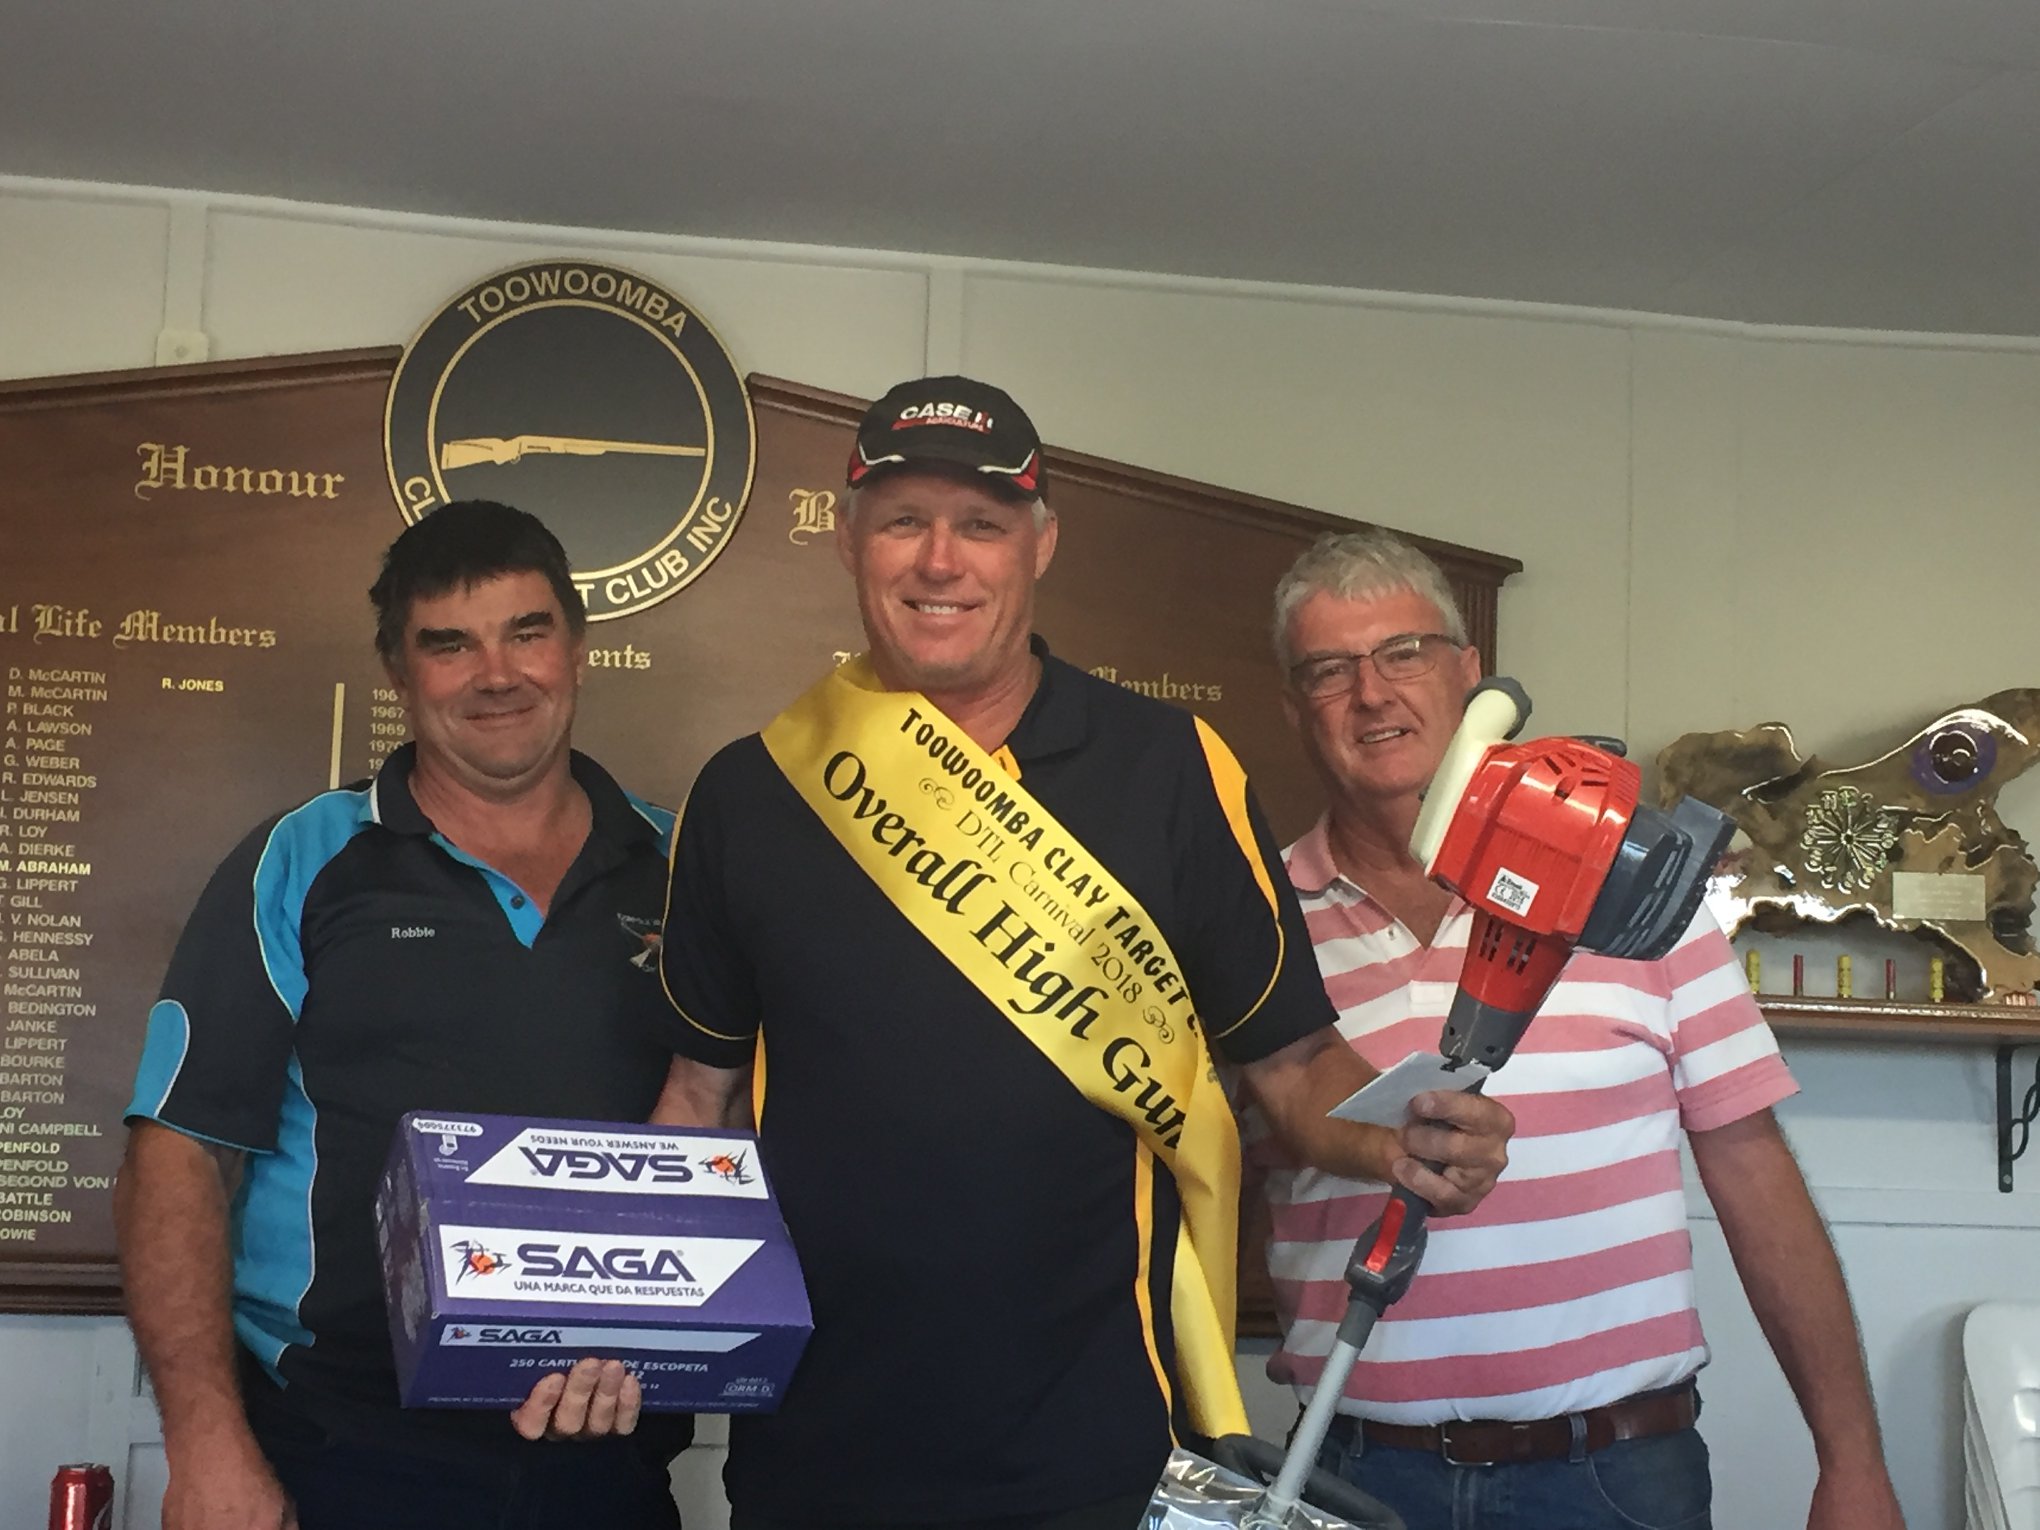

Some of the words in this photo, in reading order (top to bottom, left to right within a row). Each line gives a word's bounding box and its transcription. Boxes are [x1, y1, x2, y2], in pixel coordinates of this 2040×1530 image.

[457, 269, 688, 337] TOOWOOMBA
[900, 402, 973, 420] CASE
[134, 442, 345, 501] Honour
[404, 475, 436, 521] CL
[605, 549, 689, 604] CLUB
[686, 496, 733, 554] INC
[32, 604, 103, 645] Life
[112, 609, 277, 650] Members
[587, 644, 651, 671] ents
[29, 669, 106, 684] McCARTIN
[162, 678, 176, 690] R.
[178, 678, 224, 692] JONES
[8, 686, 25, 698] M.
[31, 686, 108, 701] McCARTIN
[372, 689, 399, 701] 196
[23, 703, 74, 717] BLACK
[371, 706, 405, 719] 1967
[6, 719, 21, 732] A.
[27, 721, 92, 736] LAWSON
[5, 737, 20, 750] A.
[26, 738, 66, 751] PAGE
[26, 755, 80, 769] WEBER
[369, 758, 385, 770] 19
[2, 772, 17, 785] R.
[22, 773, 97, 788] EDWARDS
[20, 790, 79, 804] JENSEN
[13, 807, 80, 822] DURHAM
[19, 825, 48, 838] LOY
[18, 843, 76, 857] DIERKE
[900, 708, 1044, 852] TOOWOOMBA
[1043, 847, 1110, 909] CLAY
[1104, 905, 1189, 1006] TARGET
[16, 860, 91, 875] ABRAHAM
[16, 878, 79, 892] LIPPERT
[10, 895, 43, 908] GILL
[823, 751, 996, 917] Overall
[969, 899, 1109, 1040] High
[956, 809, 1007, 863] DTL
[1008, 860, 1097, 948] Carnival
[1091, 942, 1143, 1005] 2018
[27, 913, 81, 928] NOLAN
[13, 931, 94, 946] HENNESSY
[391, 926, 436, 939] Robbie
[8, 948, 60, 962] ABELA
[8, 966, 80, 980] SULLIVAN
[4, 983, 82, 998] McCARTIN
[8, 1001, 96, 1016] BEDINGTON
[6, 1020, 57, 1033] JANKE
[5, 1036, 68, 1051] LIPPERT
[0, 1055, 65, 1069] BOURKE
[0, 1072, 63, 1087] BARTON
[0, 1090, 65, 1105] BARTON
[18, 1122, 102, 1137] CAMPBELL
[530, 1134, 568, 1146] NEEDS
[571, 1136, 604, 1148] YOUR
[606, 1139, 657, 1150] ANSWER
[660, 1142, 680, 1151] WE
[0, 1159, 69, 1173] ENFOLD
[518, 1146, 693, 1183] SAGA
[73, 1176, 110, 1190] VON
[0, 1208, 72, 1223] OBINSON
[0, 1227, 37, 1241] OWIE
[517, 1243, 697, 1282] SAGA
[514, 1280, 541, 1291] UNA
[544, 1282, 587, 1293] MARCA
[588, 1285, 613, 1295] QUE
[616, 1285, 632, 1296] DA
[635, 1286, 705, 1298] RESPUESTAS
[478, 1328, 562, 1344] SAGA
[509, 1358, 535, 1368] 250
[622, 1360, 639, 1369] DE
[643, 1361, 709, 1372] ESCOPETA
